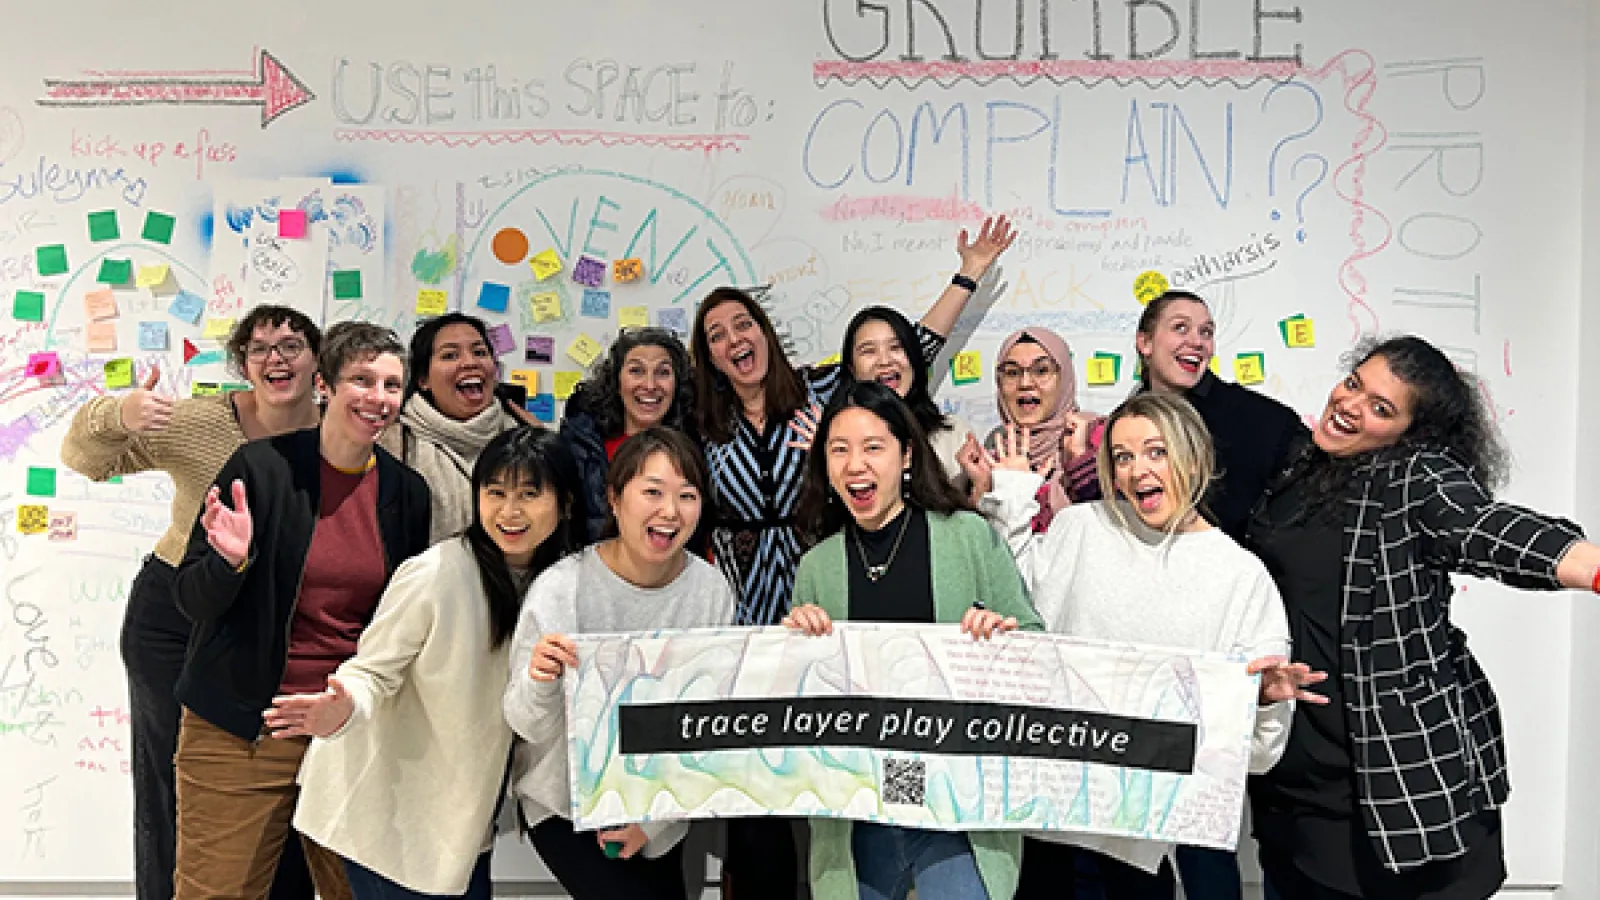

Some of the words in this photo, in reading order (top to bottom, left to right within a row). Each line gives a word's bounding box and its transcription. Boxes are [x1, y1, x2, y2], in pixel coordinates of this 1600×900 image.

[332, 55, 457, 125] USE
[562, 58, 700, 126] SPACE
[534, 195, 737, 304] VENT
[1171, 232, 1283, 288] catharsis
[680, 713, 770, 740] trace
[781, 707, 870, 741] layer
[879, 707, 953, 746] play
[966, 715, 1130, 752] collective
